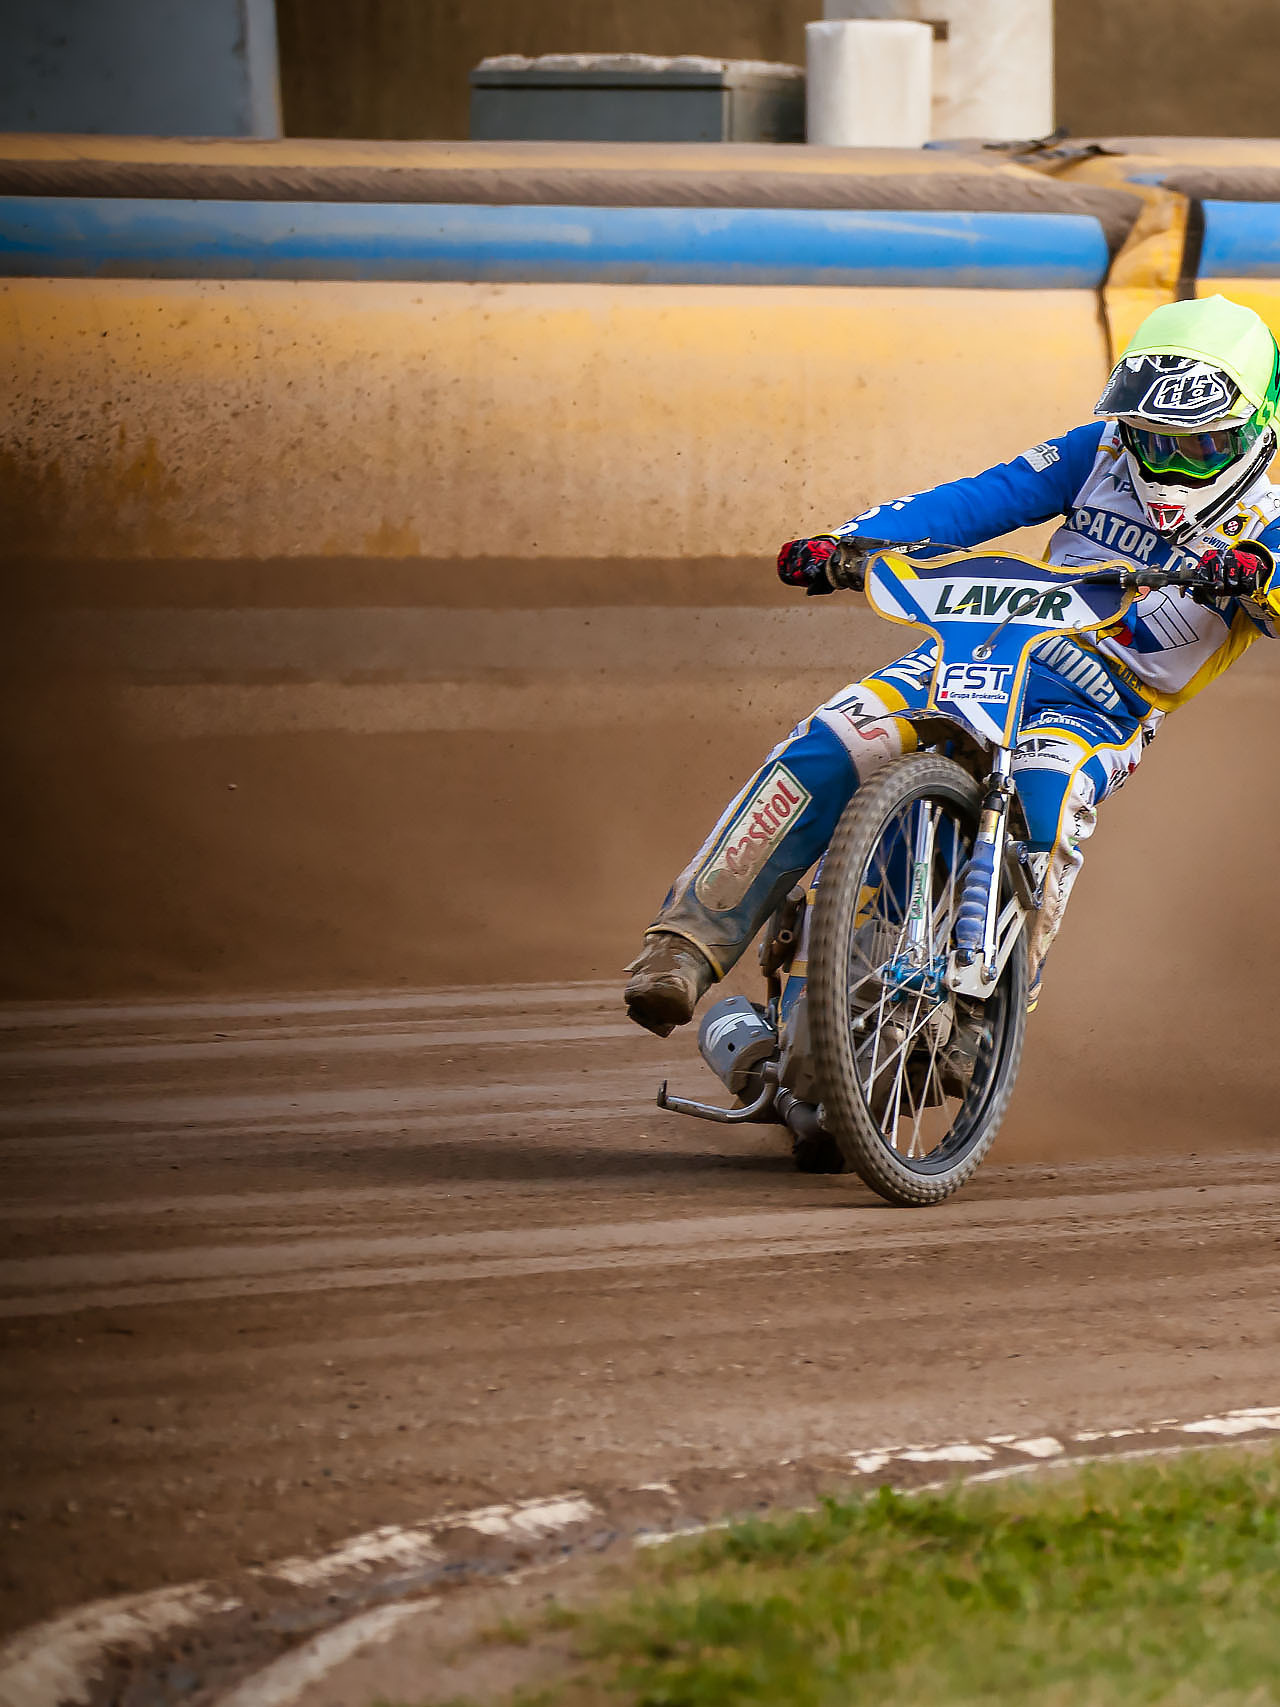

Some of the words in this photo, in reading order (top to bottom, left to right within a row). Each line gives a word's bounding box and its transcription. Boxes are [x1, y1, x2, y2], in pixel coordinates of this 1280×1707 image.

[934, 584, 1072, 621] LAVOR
[942, 666, 1010, 690] FST
[725, 779, 800, 876] Castrol
